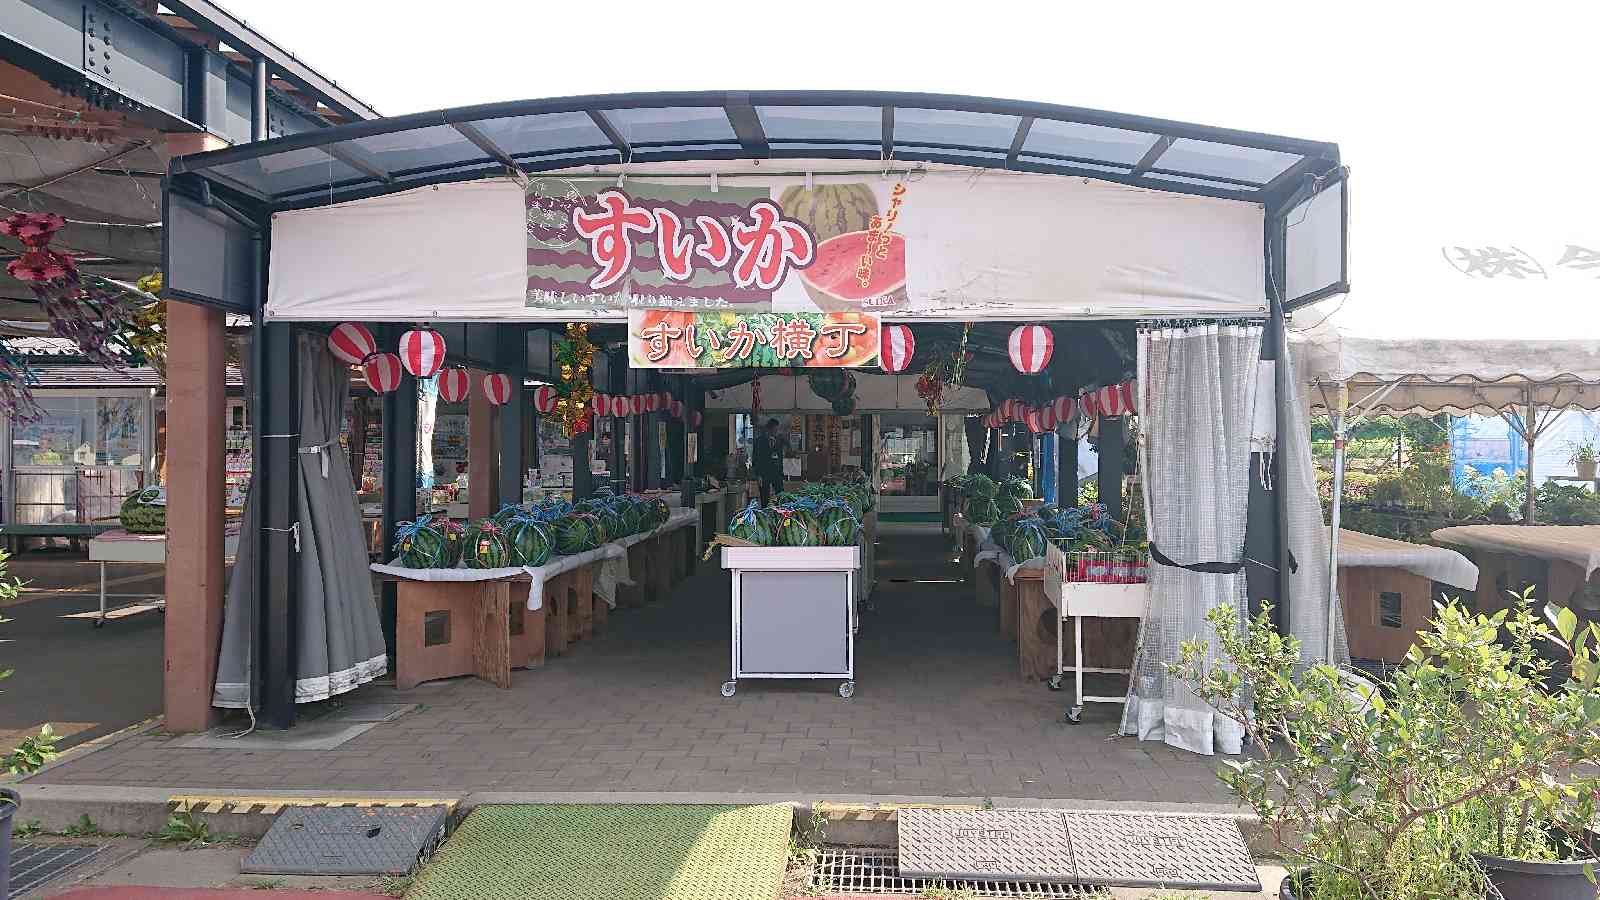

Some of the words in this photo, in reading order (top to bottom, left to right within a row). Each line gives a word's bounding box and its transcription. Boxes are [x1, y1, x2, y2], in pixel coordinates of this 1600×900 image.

[573, 189, 813, 291] すいか
[641, 318, 868, 362] すいか横丁
